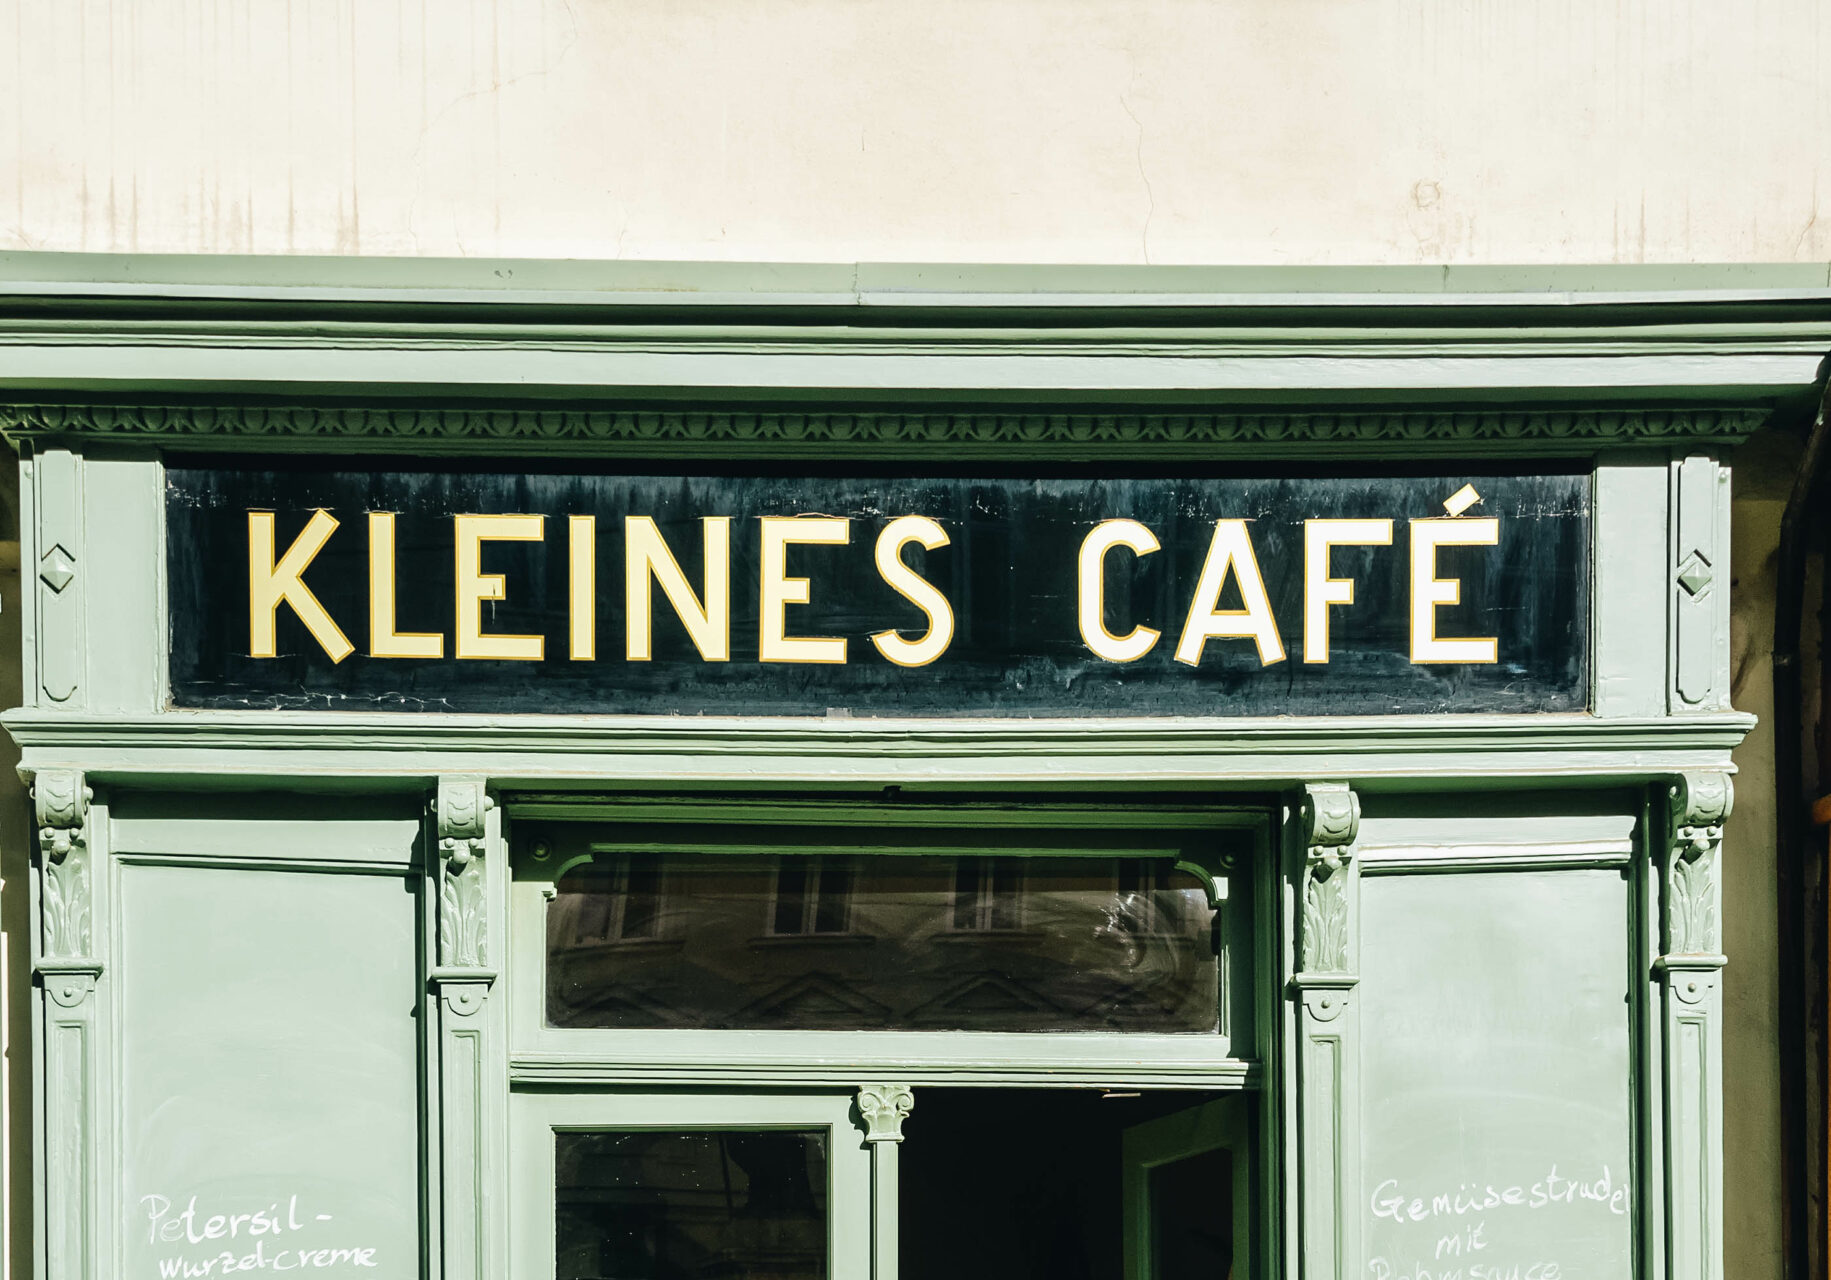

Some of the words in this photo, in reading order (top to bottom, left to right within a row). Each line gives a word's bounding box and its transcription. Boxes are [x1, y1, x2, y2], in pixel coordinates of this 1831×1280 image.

[248, 507, 955, 667] KLEINES
[1078, 483, 1500, 667] CAFÉ
[1435, 1219, 1488, 1259] mit
